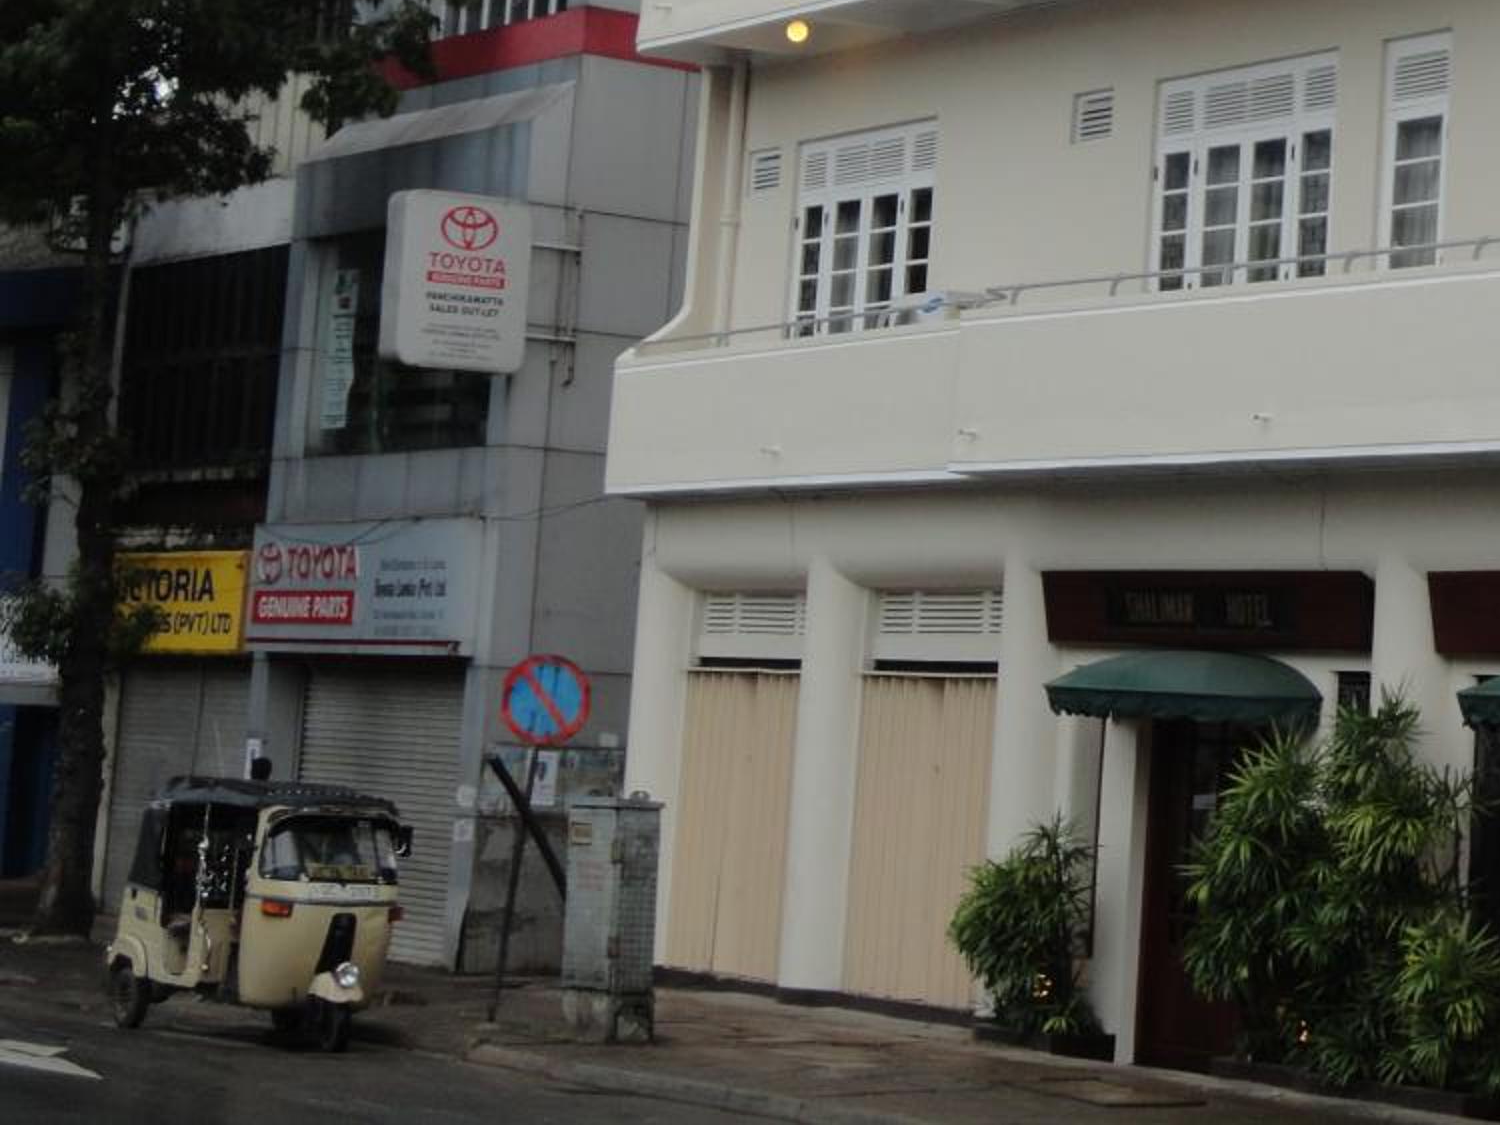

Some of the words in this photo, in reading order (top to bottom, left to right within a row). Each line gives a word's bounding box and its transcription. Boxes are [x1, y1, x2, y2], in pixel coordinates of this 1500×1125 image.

[430, 253, 505, 273] TOYOTA
[286, 545, 358, 581] TOYOTA
[257, 595, 310, 618] GENUINE
[312, 595, 349, 618] PARTS
